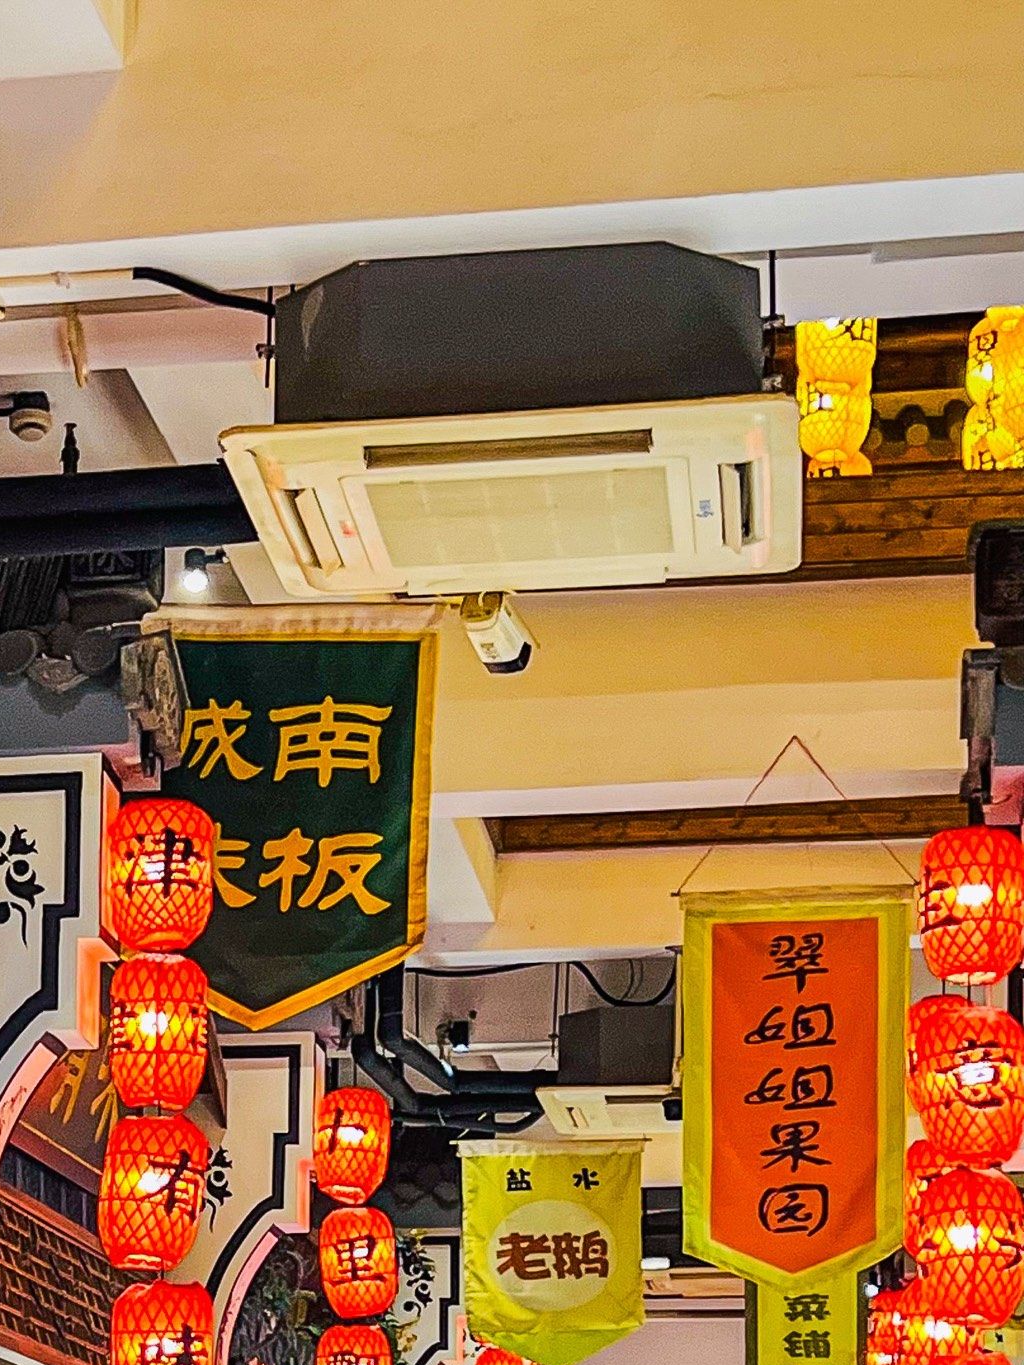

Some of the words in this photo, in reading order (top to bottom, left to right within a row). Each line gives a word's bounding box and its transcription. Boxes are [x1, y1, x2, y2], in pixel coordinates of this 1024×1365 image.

[123, 827, 206, 900] 津
[742, 931, 837, 1237] 翠姐姐果园
[506, 1168, 601, 1192] 盐水
[330, 1236, 388, 1288] 里
[496, 1230, 610, 1281] 老鹅
